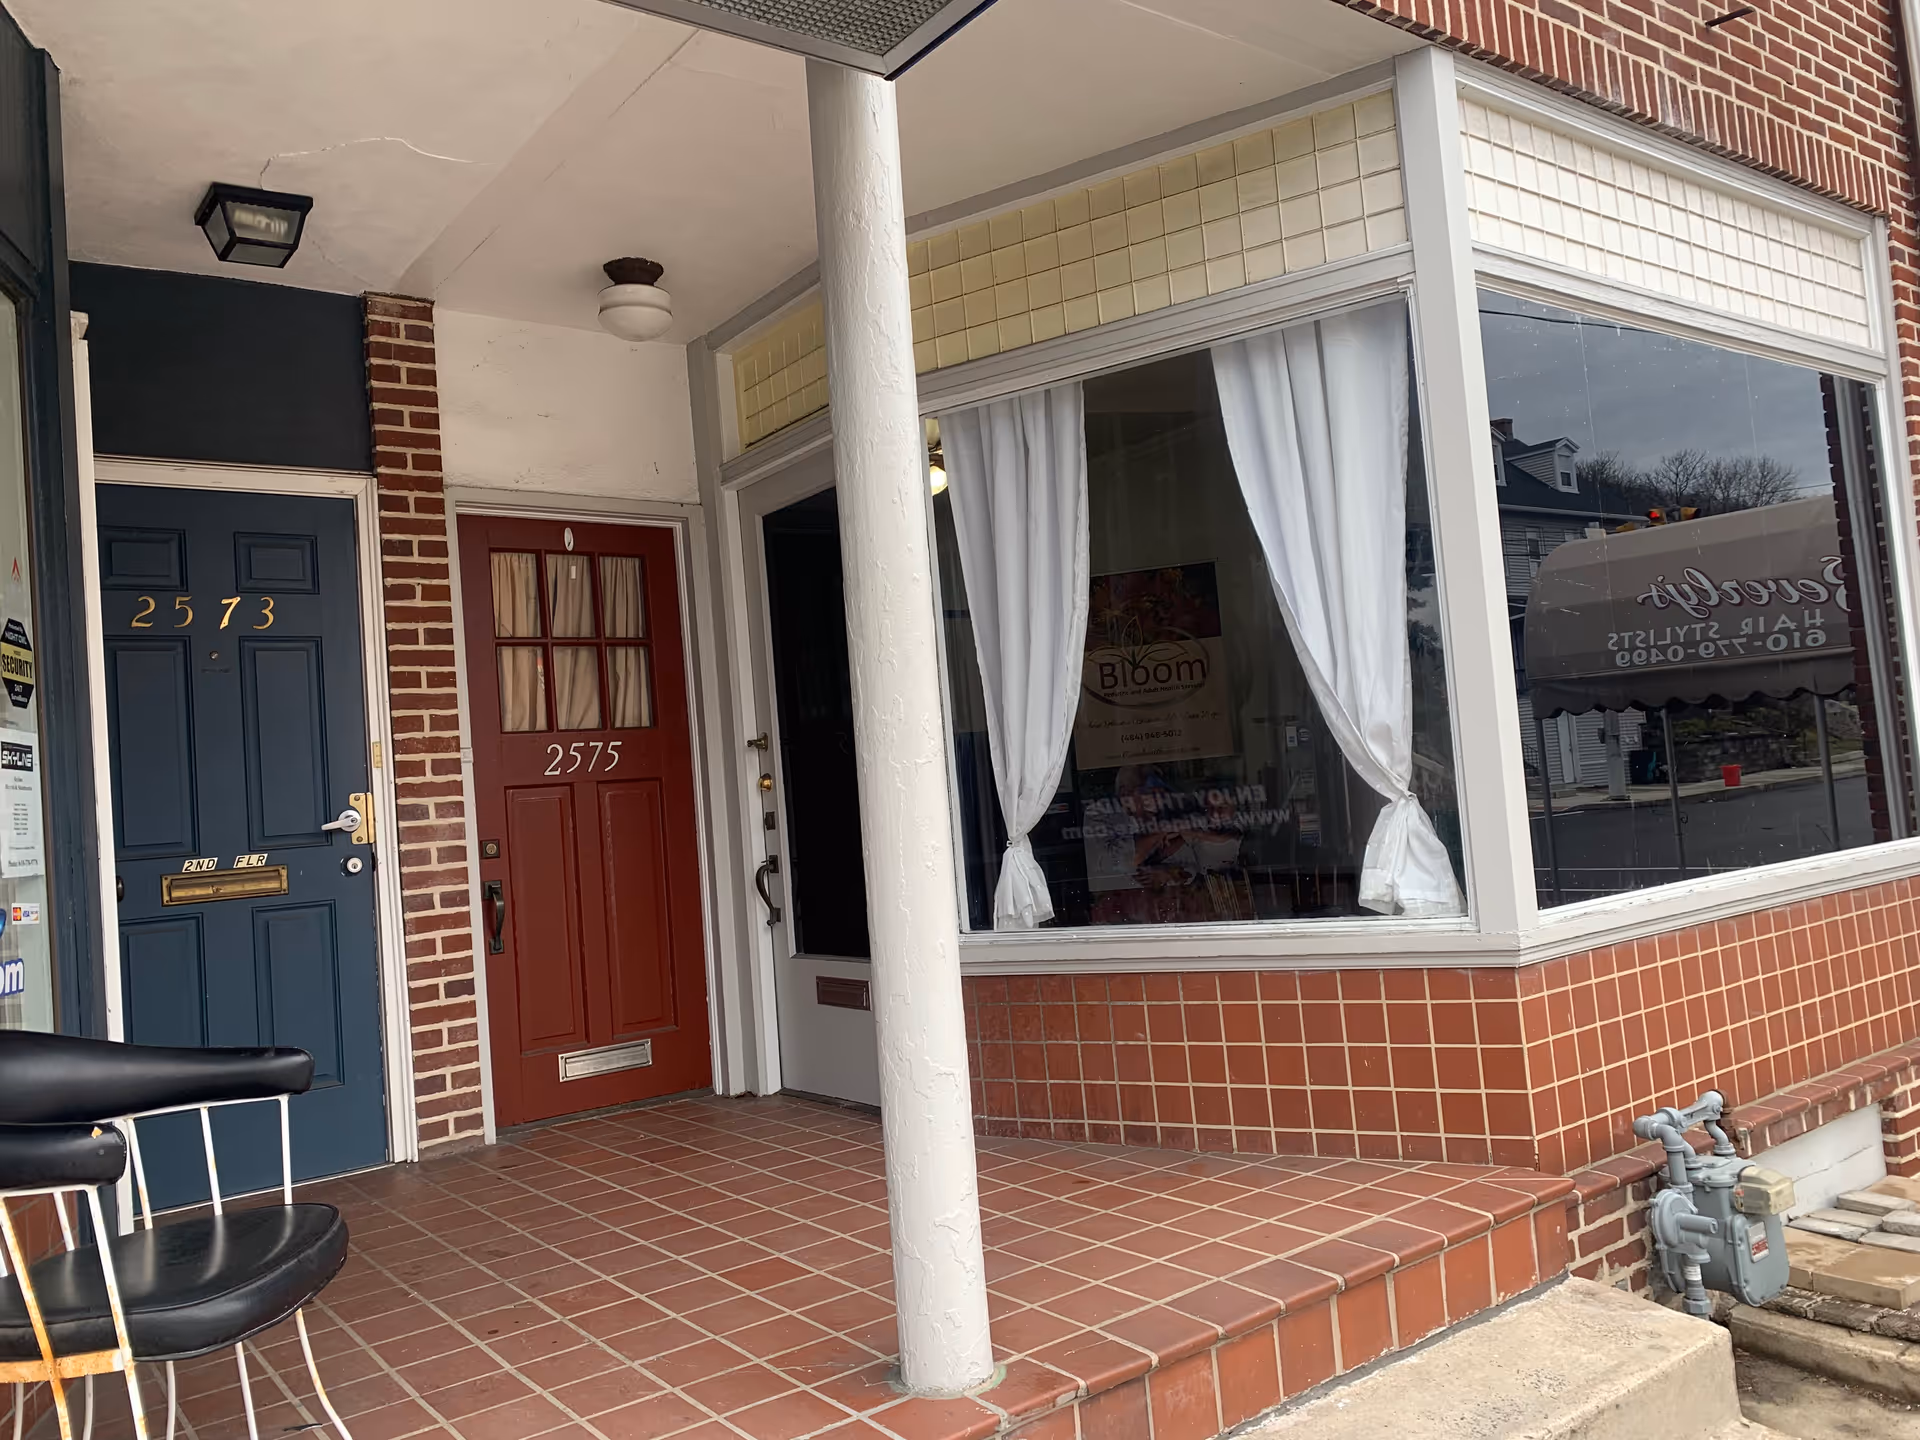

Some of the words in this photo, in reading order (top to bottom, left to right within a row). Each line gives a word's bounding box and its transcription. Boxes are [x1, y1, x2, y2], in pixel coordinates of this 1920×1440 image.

[130, 596, 276, 630] 2573
[1, 653, 33, 678] SECURITY
[1099, 658, 1206, 690] Bloom
[543, 740, 622, 776] 2575
[184, 858, 218, 872] 2ND
[234, 854, 268, 868] FLR
